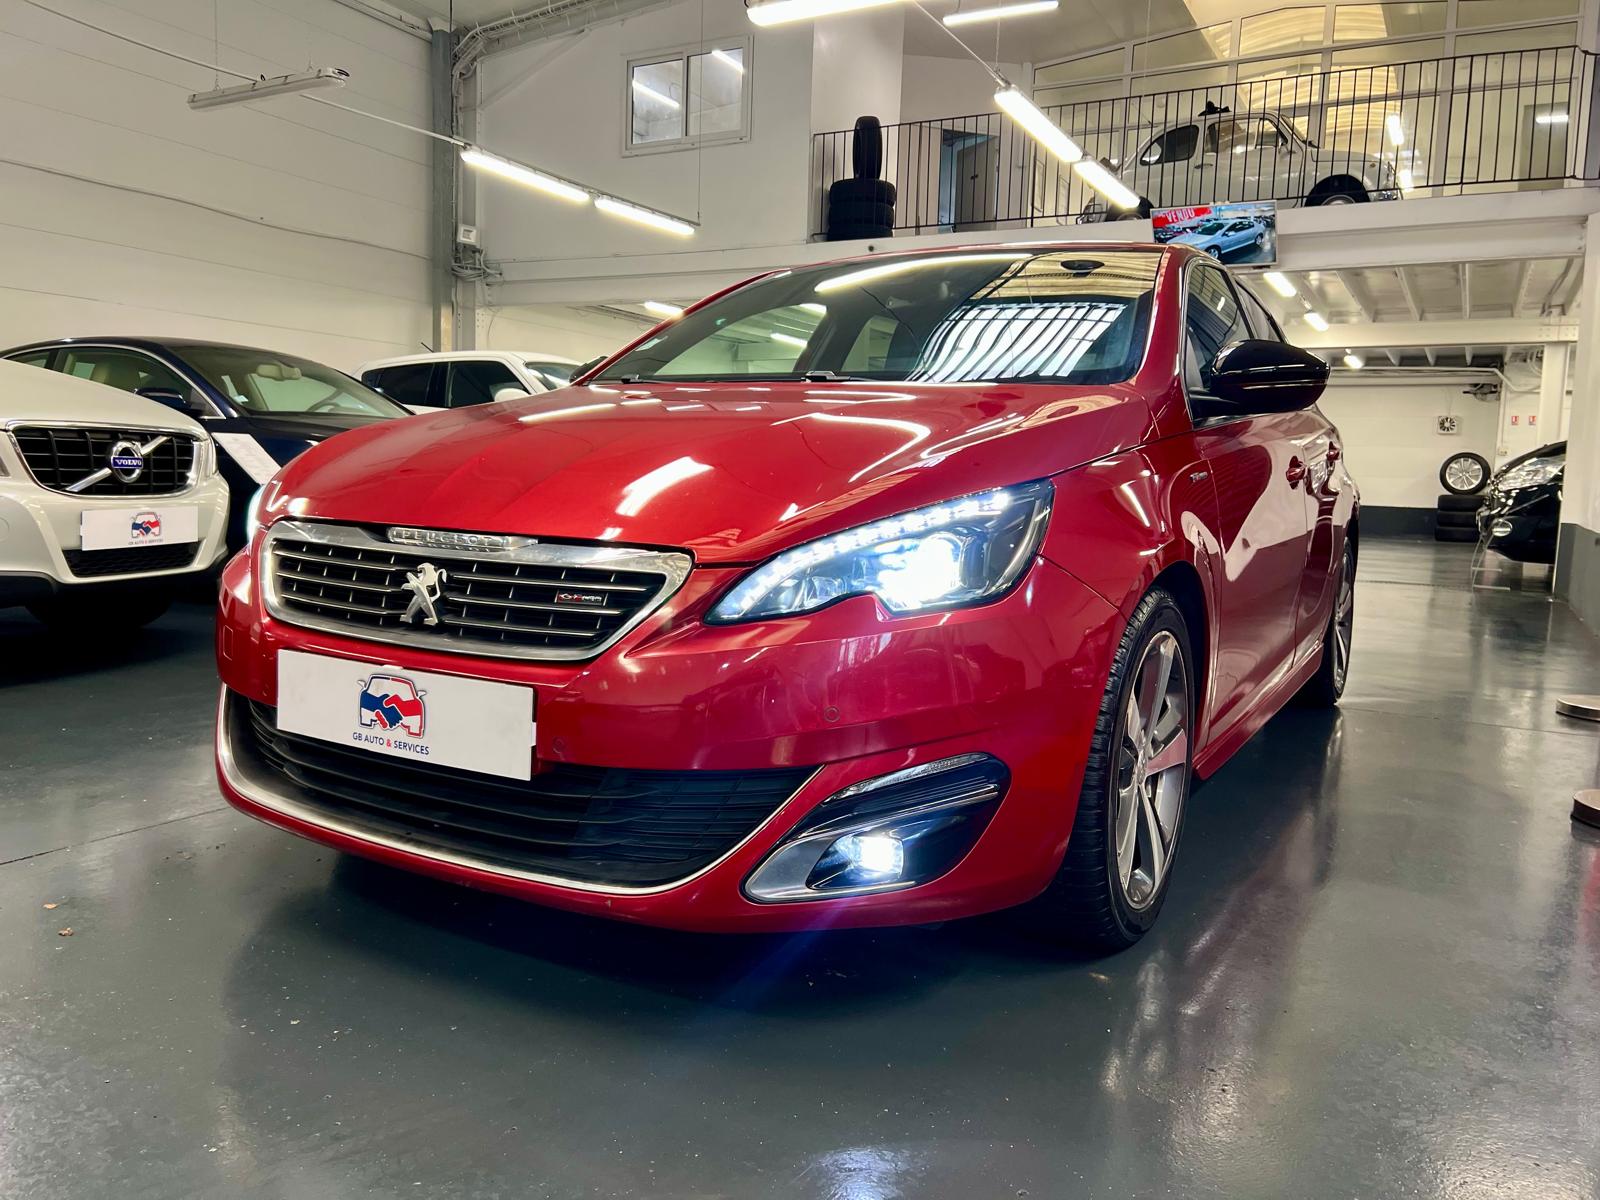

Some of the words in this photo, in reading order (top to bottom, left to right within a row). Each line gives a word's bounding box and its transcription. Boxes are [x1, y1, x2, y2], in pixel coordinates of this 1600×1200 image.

[402, 530, 492, 546] PEUGEOT
[352, 732, 363, 741] GB
[364, 734, 385, 746] AUTO
[386, 739, 392, 748] &
[393, 740, 430, 755] SERVICES
